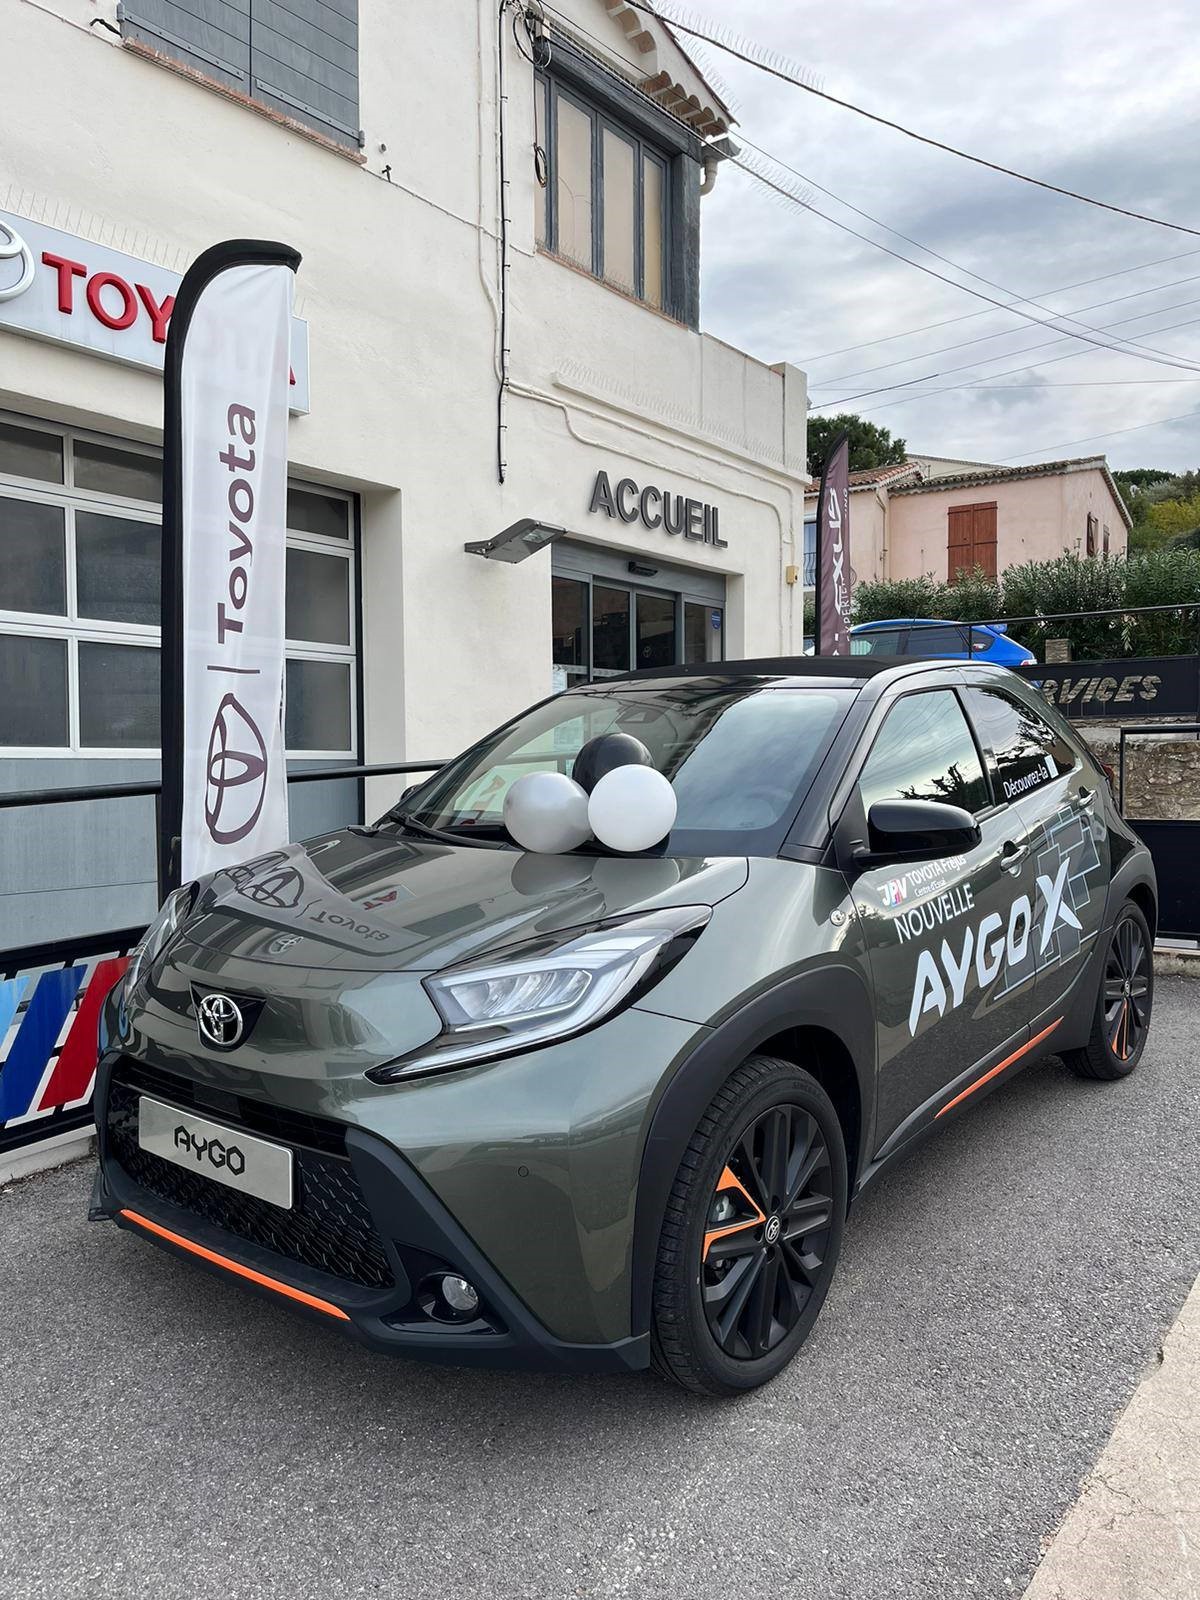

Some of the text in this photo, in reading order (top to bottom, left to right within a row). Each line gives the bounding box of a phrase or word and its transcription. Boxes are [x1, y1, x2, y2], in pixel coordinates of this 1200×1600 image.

[217, 402, 256, 645] Toyota
[589, 470, 728, 548] ACCUEIL
[1031, 675, 1162, 705] RVICES
[1003, 763, 1049, 798] Découvrez-la
[905, 861, 944, 887] TOYOTA
[893, 883, 976, 944] NOUVELLE
[909, 857, 1083, 1037] AYGO X
[174, 1125, 245, 1176] AYGO
